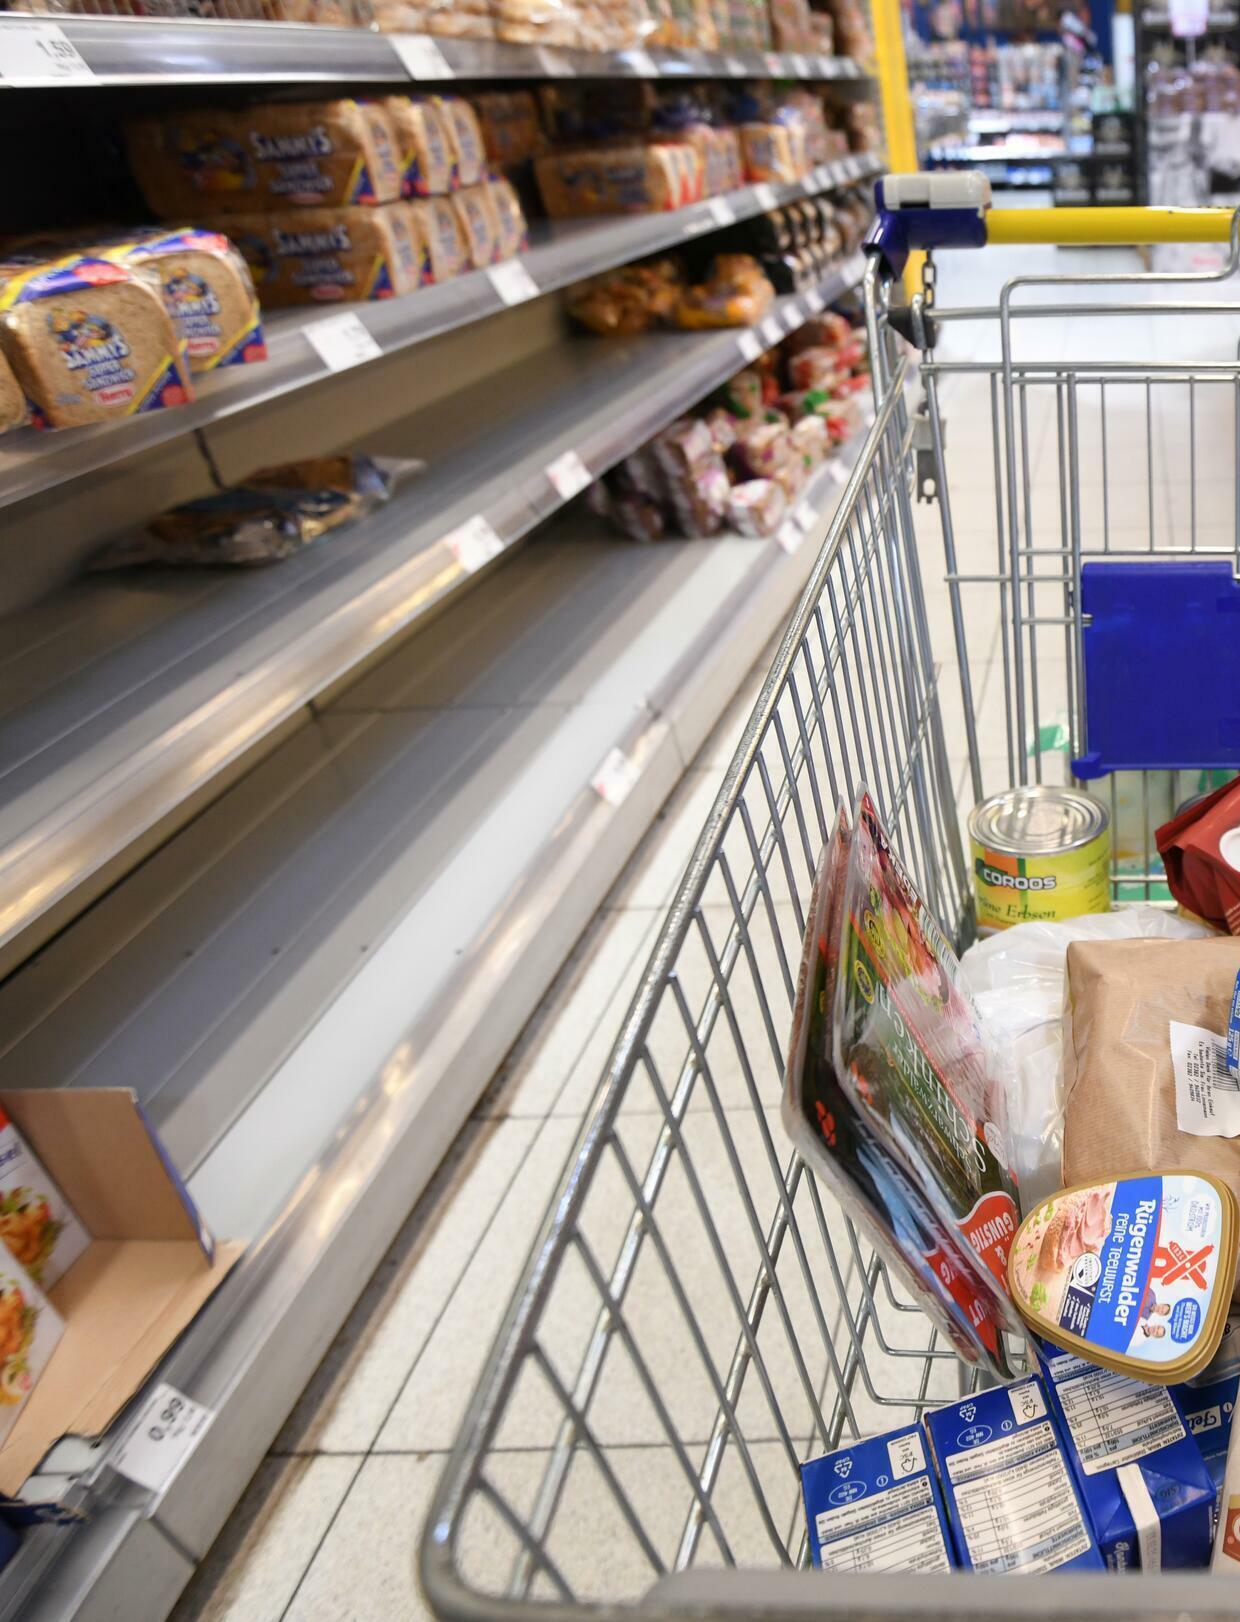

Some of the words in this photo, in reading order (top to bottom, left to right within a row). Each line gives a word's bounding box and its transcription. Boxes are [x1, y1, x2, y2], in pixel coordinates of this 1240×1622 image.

[984, 868, 1056, 889] COROOS
[1006, 905, 1056, 919] Erbsen
[877, 982, 984, 1171] Schinken
[969, 1211, 1015, 1252] GÜNSTIG
[994, 1244, 1008, 1267] &
[1113, 1200, 1156, 1326] Rügenwalder
